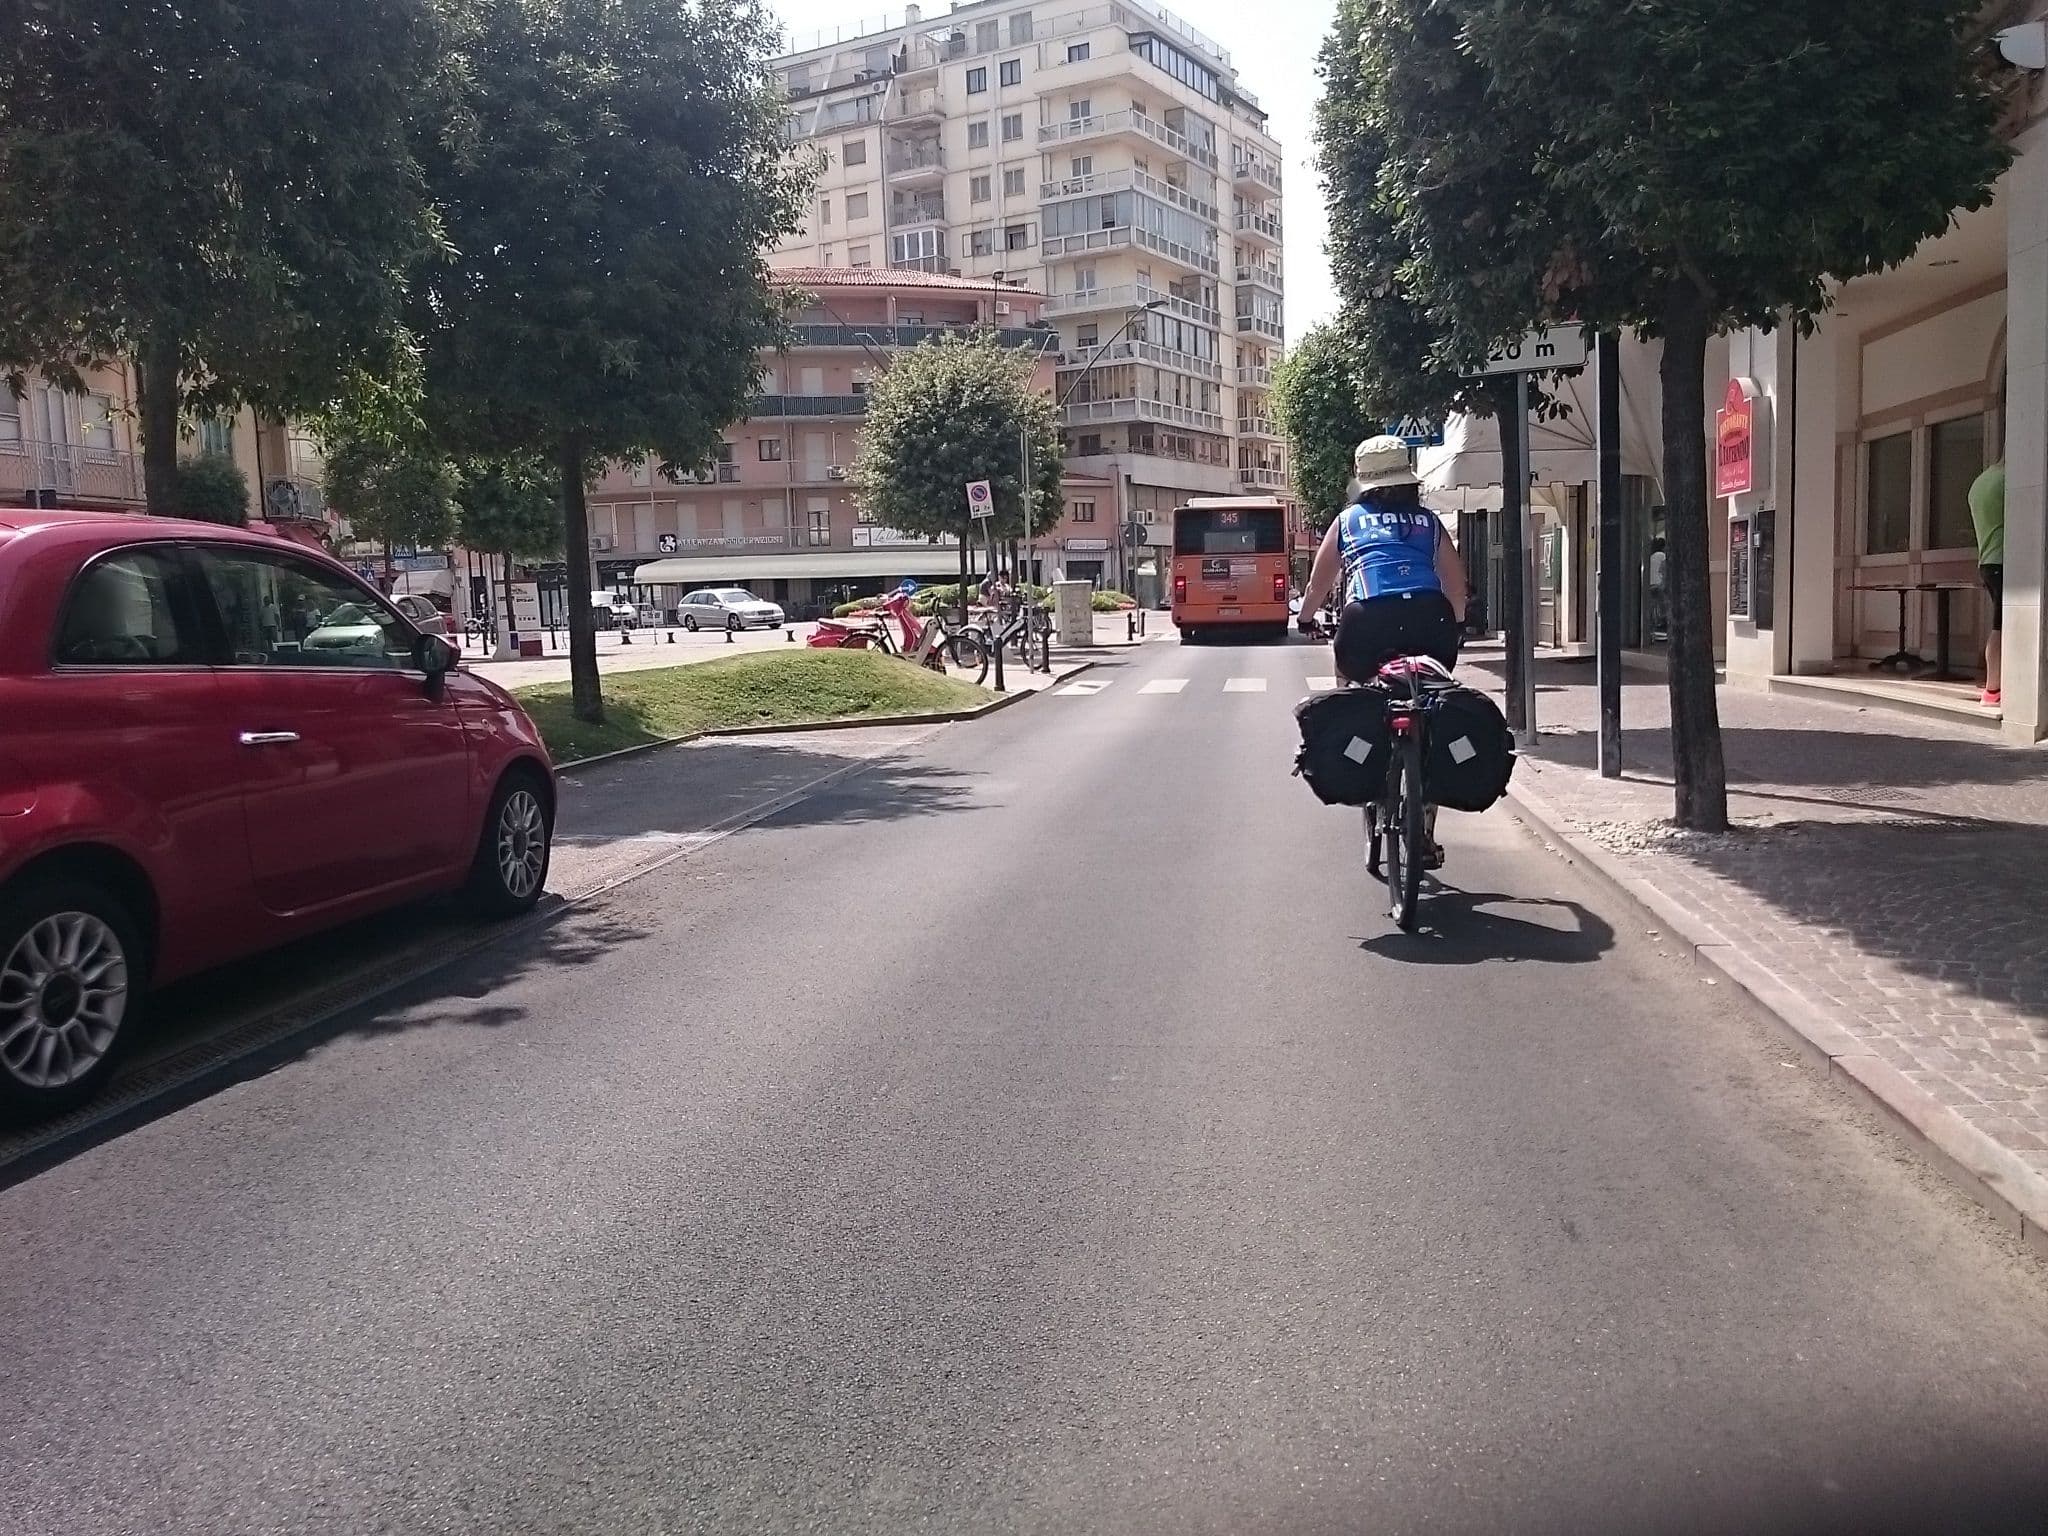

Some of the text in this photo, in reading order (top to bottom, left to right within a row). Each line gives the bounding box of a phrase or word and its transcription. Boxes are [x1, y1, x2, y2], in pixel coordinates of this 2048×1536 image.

[1536, 343, 1555, 357] m
[1221, 513, 1238, 524] 345
[1358, 513, 1429, 529] ITALIA
